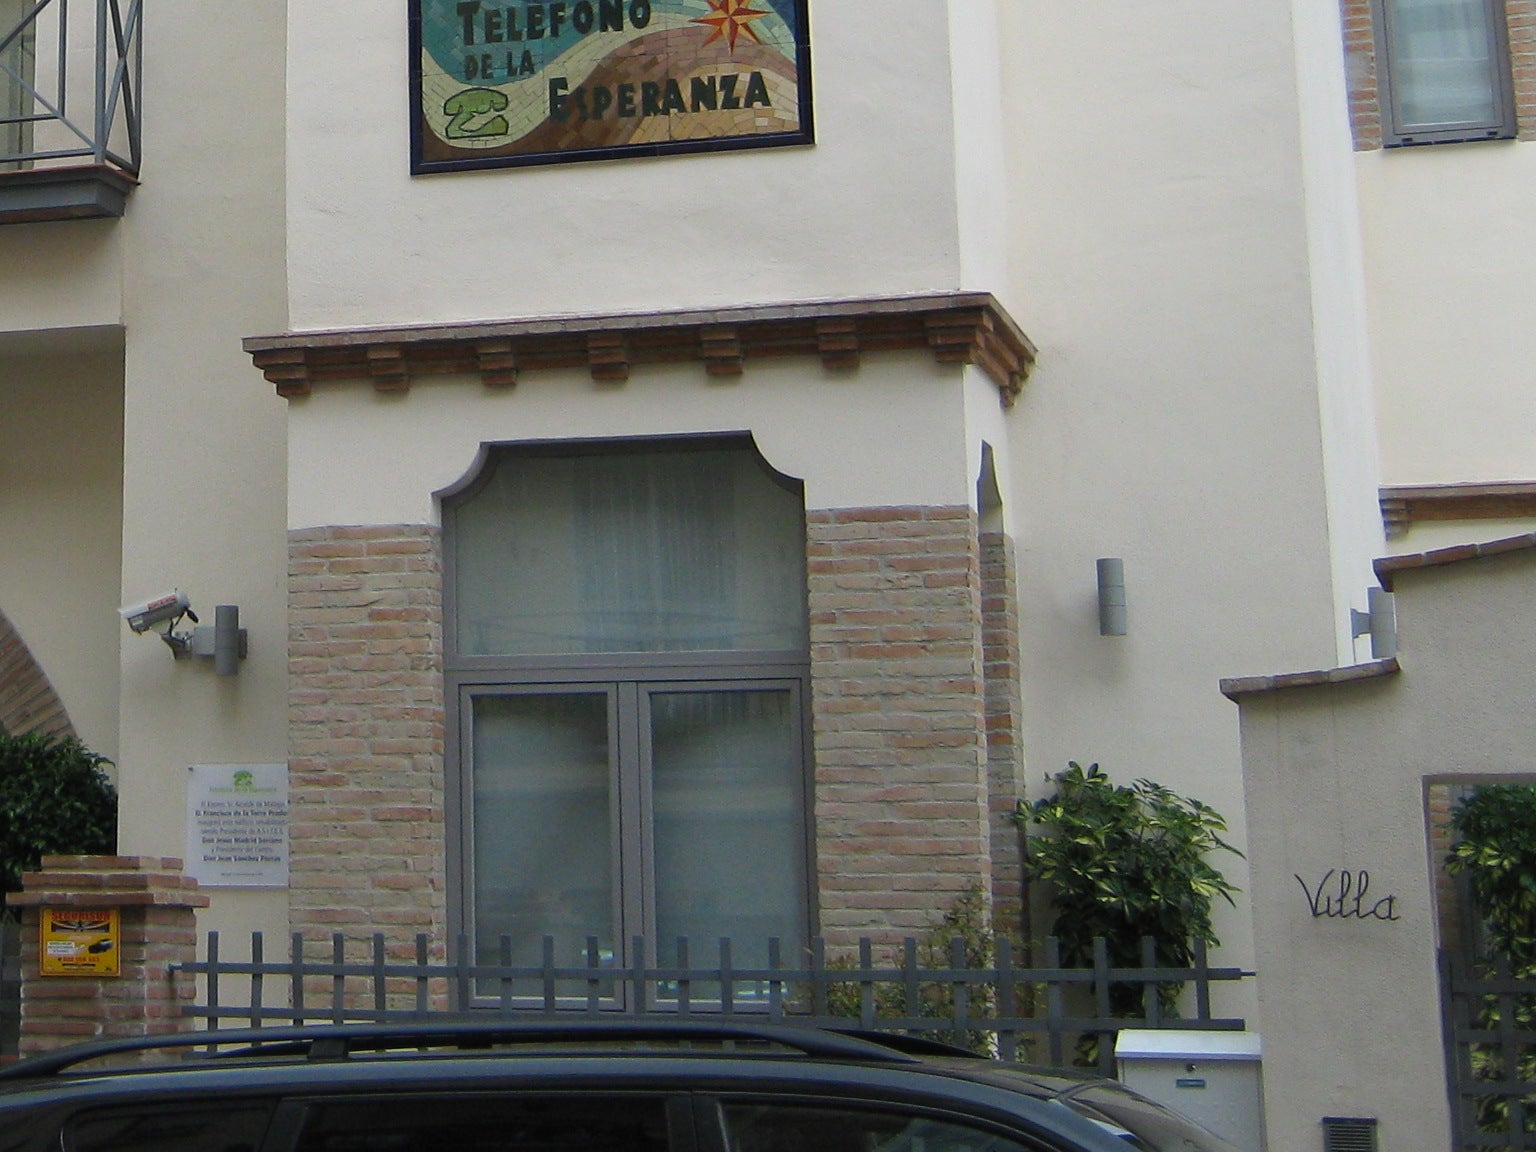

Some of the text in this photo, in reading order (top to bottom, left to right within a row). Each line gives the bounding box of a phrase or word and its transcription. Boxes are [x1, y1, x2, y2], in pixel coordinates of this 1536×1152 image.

[465, 50, 535, 81] DE LA
[548, 71, 772, 124] ESPERANZA
[1293, 868, 1401, 921] Villa
